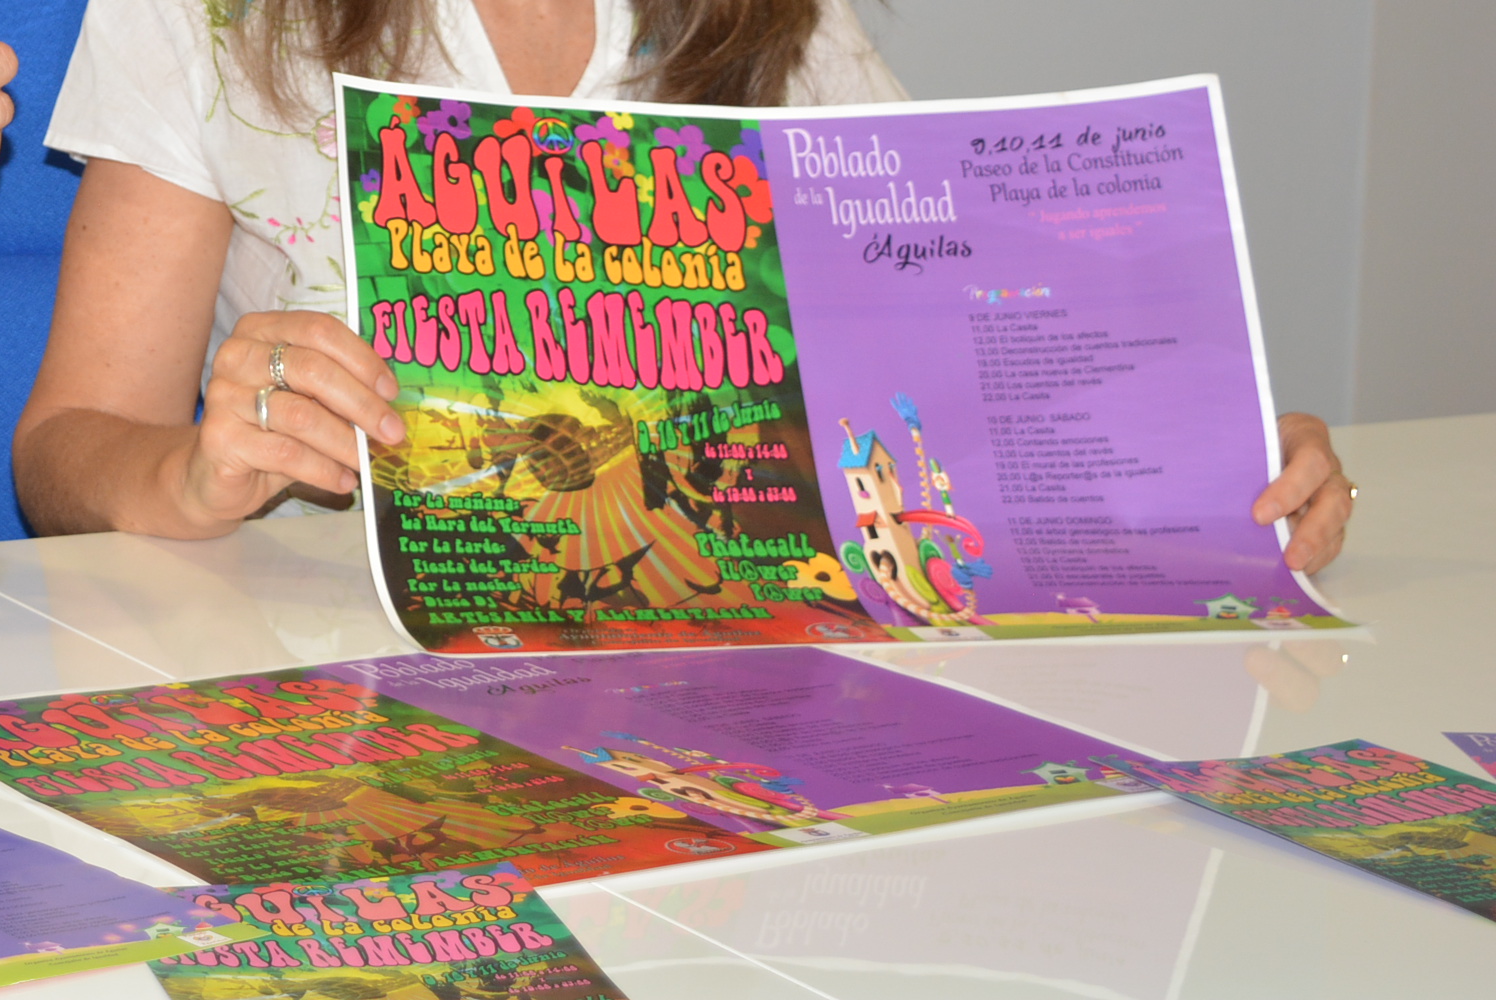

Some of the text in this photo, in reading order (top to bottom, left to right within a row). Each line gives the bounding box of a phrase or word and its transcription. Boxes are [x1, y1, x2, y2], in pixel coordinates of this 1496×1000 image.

[782, 127, 901, 179] Poblado
[960, 145, 1184, 178] Paseo de la Constitución
[1076, 125, 1101, 146] de
[1112, 123, 1166, 152] junio
[373, 115, 747, 253] ÁGUILAS
[825, 179, 957, 239] Igualdad
[989, 175, 1162, 206] Playa de la colonia
[504, 222, 545, 280] de
[371, 287, 785, 391] FIESTA REMEMBER
